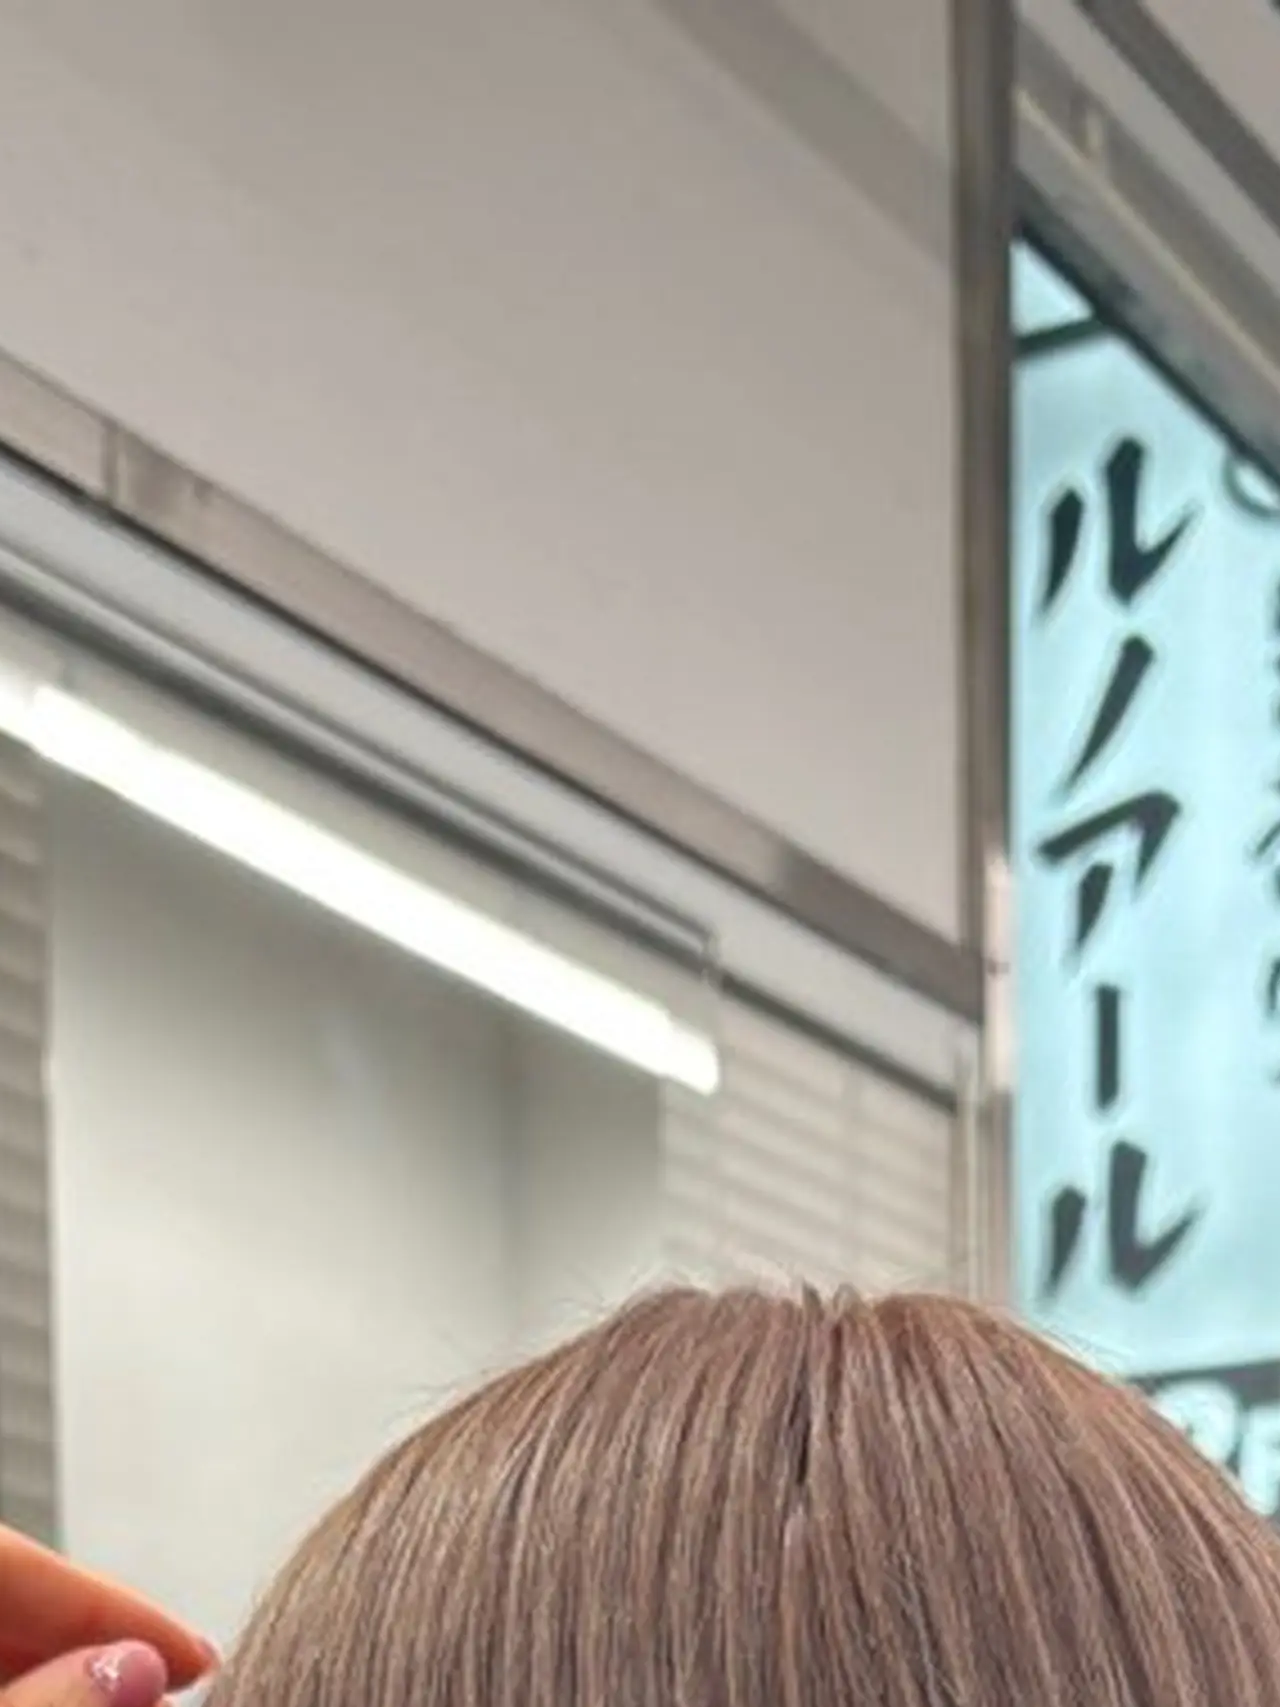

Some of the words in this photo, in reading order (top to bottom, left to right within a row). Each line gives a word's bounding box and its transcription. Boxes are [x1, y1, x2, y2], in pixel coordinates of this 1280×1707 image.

[1036, 436, 1202, 1301] ルノアール
